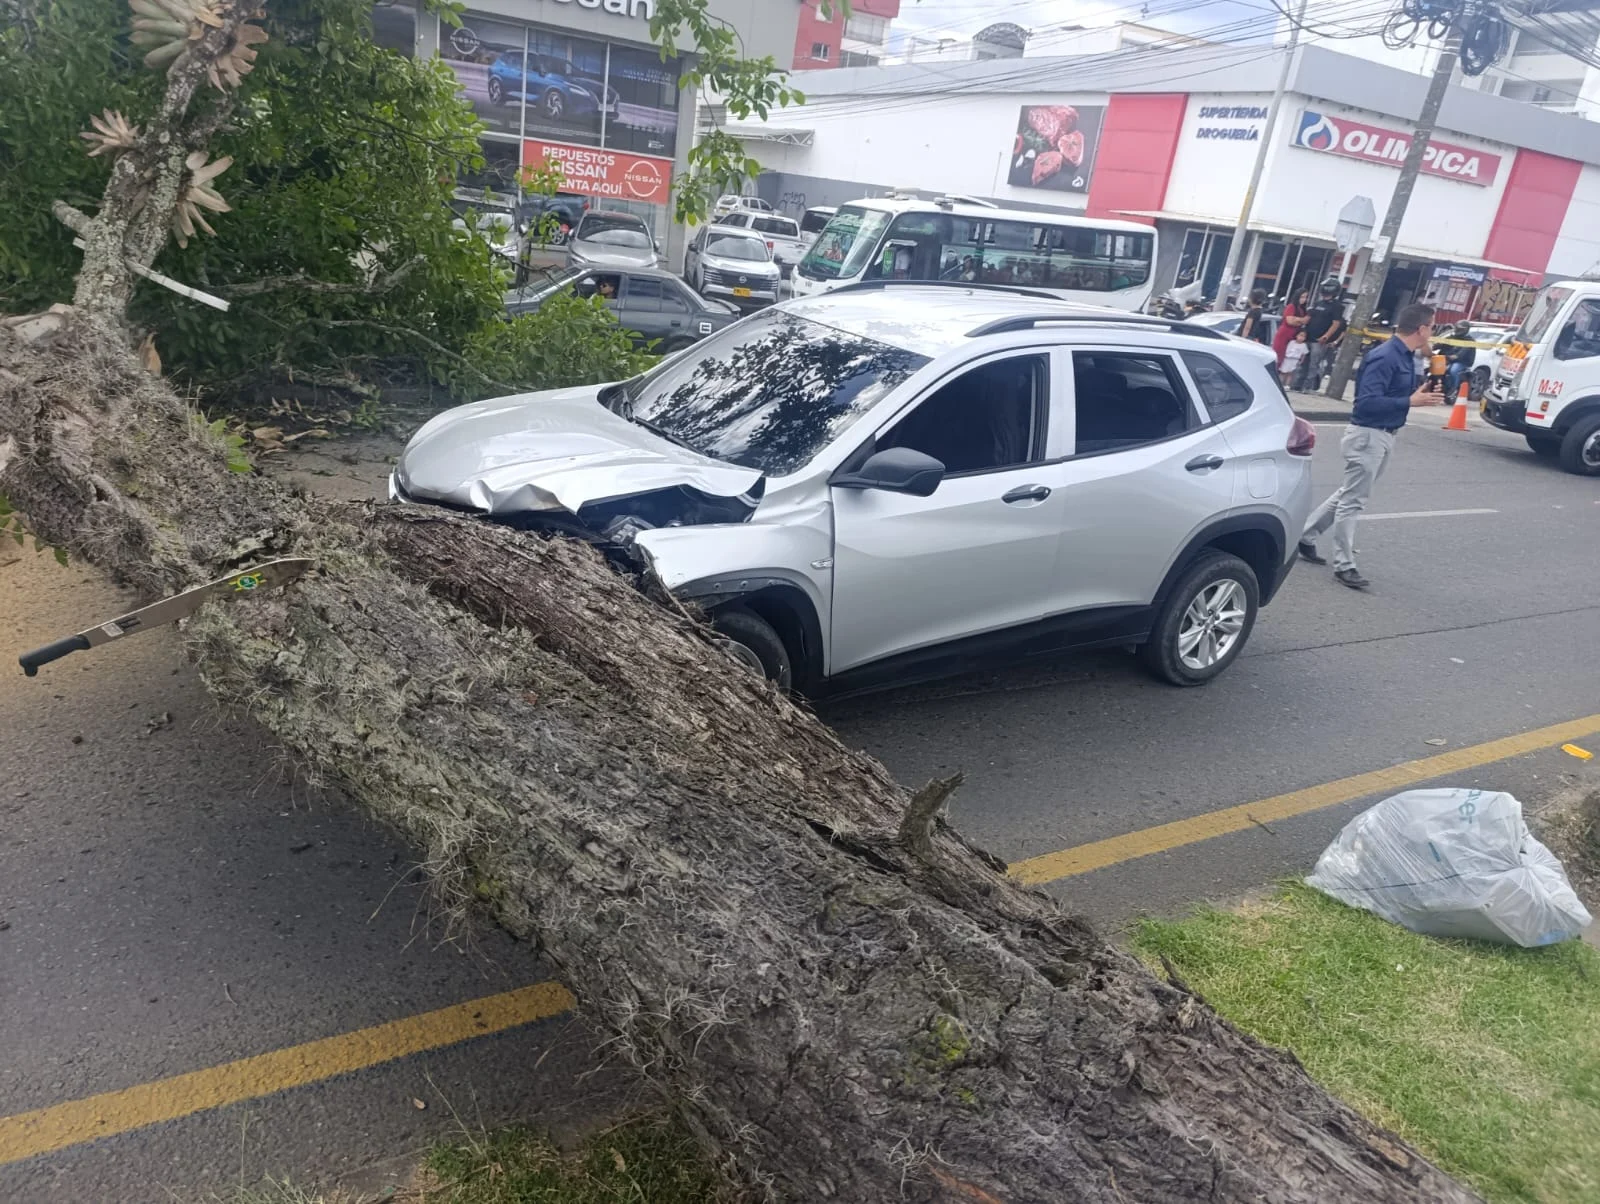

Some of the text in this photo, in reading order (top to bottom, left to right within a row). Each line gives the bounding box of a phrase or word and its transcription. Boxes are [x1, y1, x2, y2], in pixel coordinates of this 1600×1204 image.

[1198, 106, 1268, 119] SUPERTIENDA
[1196, 125, 1259, 140] DROGUERÍA
[542, 146, 616, 166] REPUESTOS
[549, 159, 608, 179] NISSAN
[625, 173, 662, 185] NISSAN
[591, 182, 623, 195] AQUÍ
[1538, 379, 1564, 395] M-21
